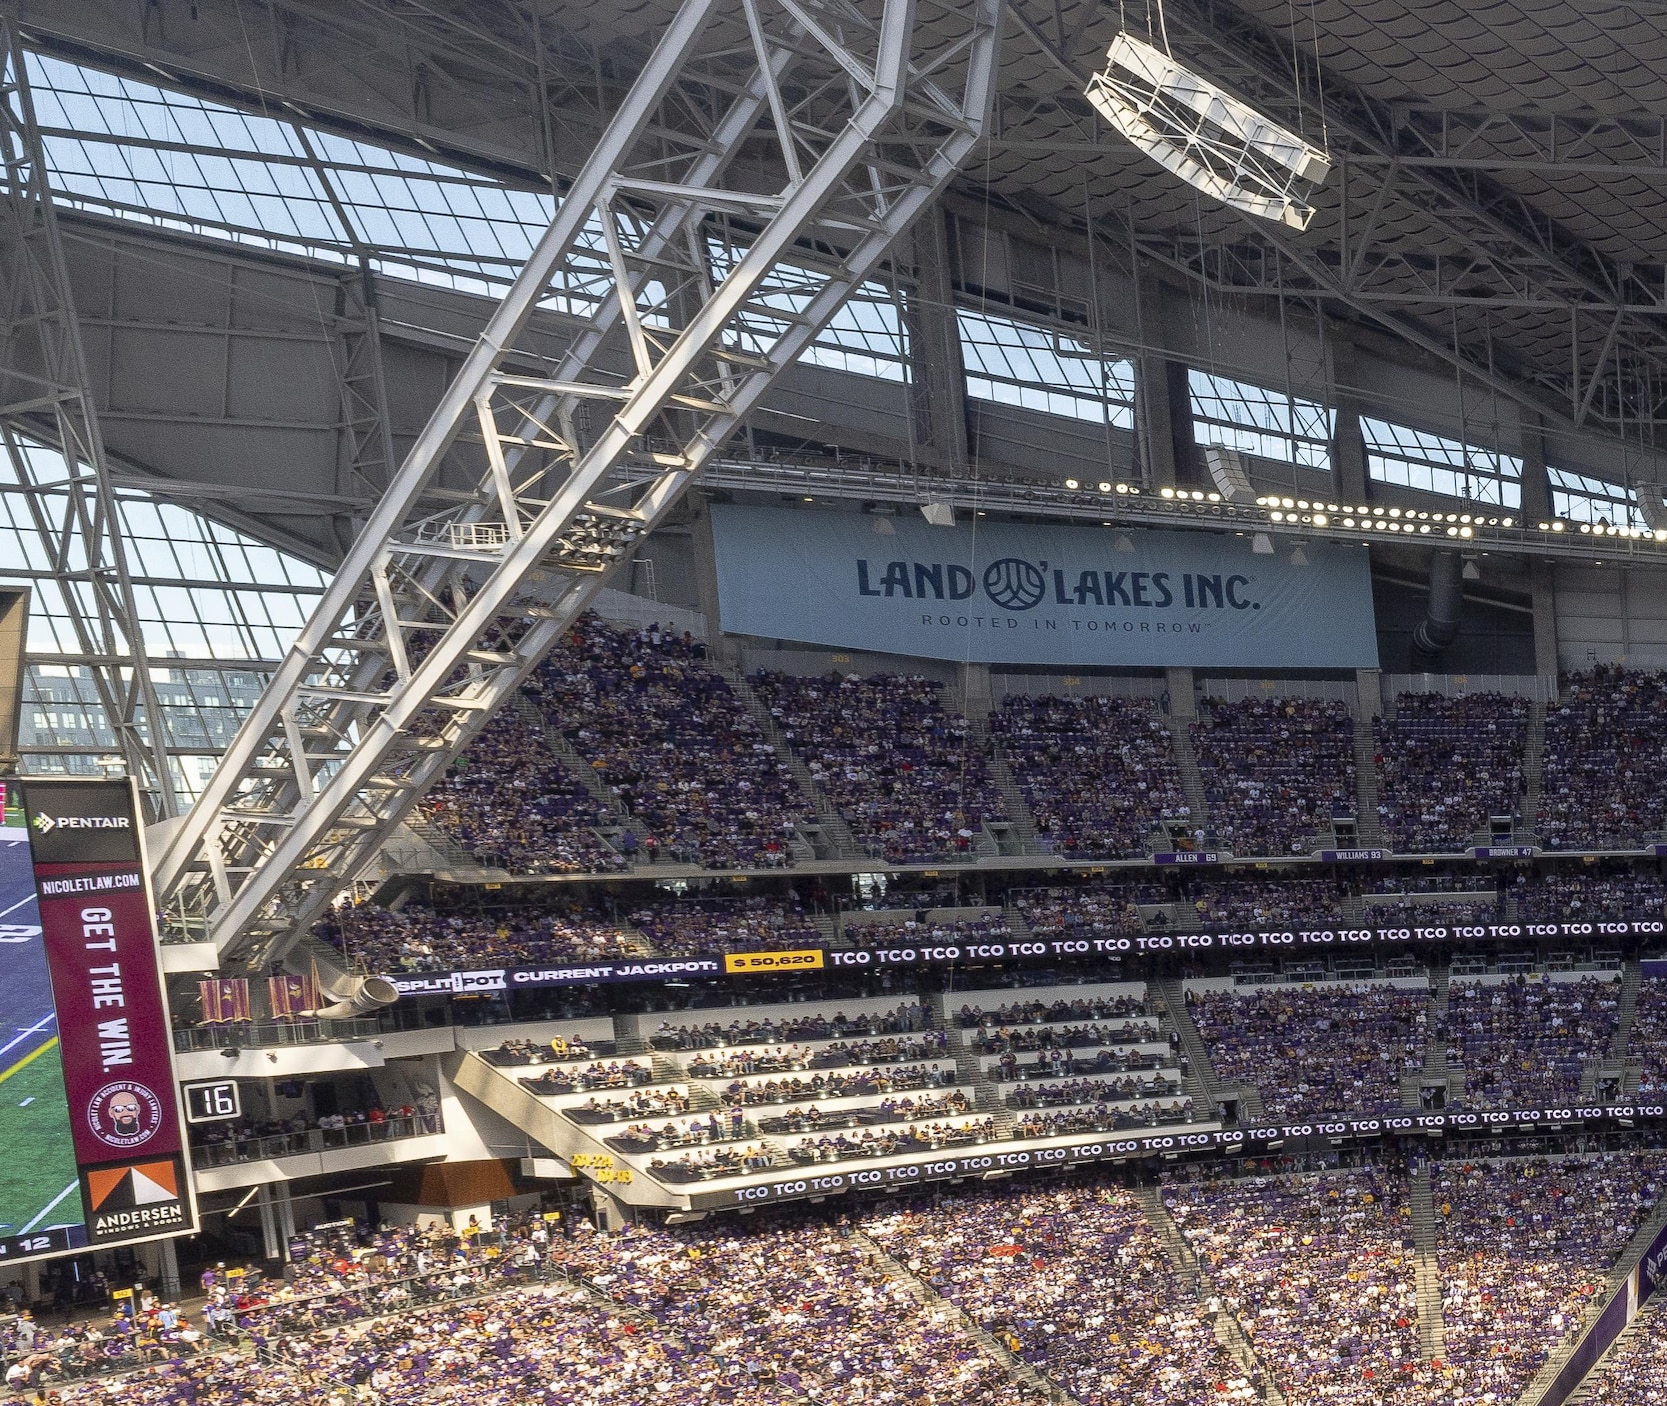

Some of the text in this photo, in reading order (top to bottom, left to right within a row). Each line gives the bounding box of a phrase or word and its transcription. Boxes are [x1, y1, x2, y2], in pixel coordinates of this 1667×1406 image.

[856, 559, 977, 601] LAND
[1182, 574, 1262, 611] INC.
[922, 615, 1019, 630] ROOTED
[1035, 620, 1056, 631] IN
[57, 817, 130, 829] PENTAIR
[1175, 854, 1199, 863] ALLEN
[1336, 851, 1382, 860] WILLIAMS 93
[43, 874, 140, 895] NICOLETLAW.COM
[79, 907, 118, 952] GET
[830, 950, 872, 966] TCO
[1176, 934, 1213, 947] TCO
[1337, 929, 1372, 942] TCO
[1488, 925, 1521, 937] TCO
[513, 960, 719, 983] CURRENT JACKPOT:
[733, 955, 816, 968] $ 50,620
[88, 963, 125, 1010] THE
[397, 979, 452, 992] SPLIT
[462, 976, 503, 989] POT
[97, 1017, 134, 1074] WIN.
[202, 1086, 234, 1115] 16
[847, 1169, 883, 1184] TCO
[1281, 1119, 1313, 1137] TCO
[1637, 1101, 1664, 1116] TCO
[96, 1204, 182, 1230] ANDERSEN
[20, 1236, 51, 1250] 12
